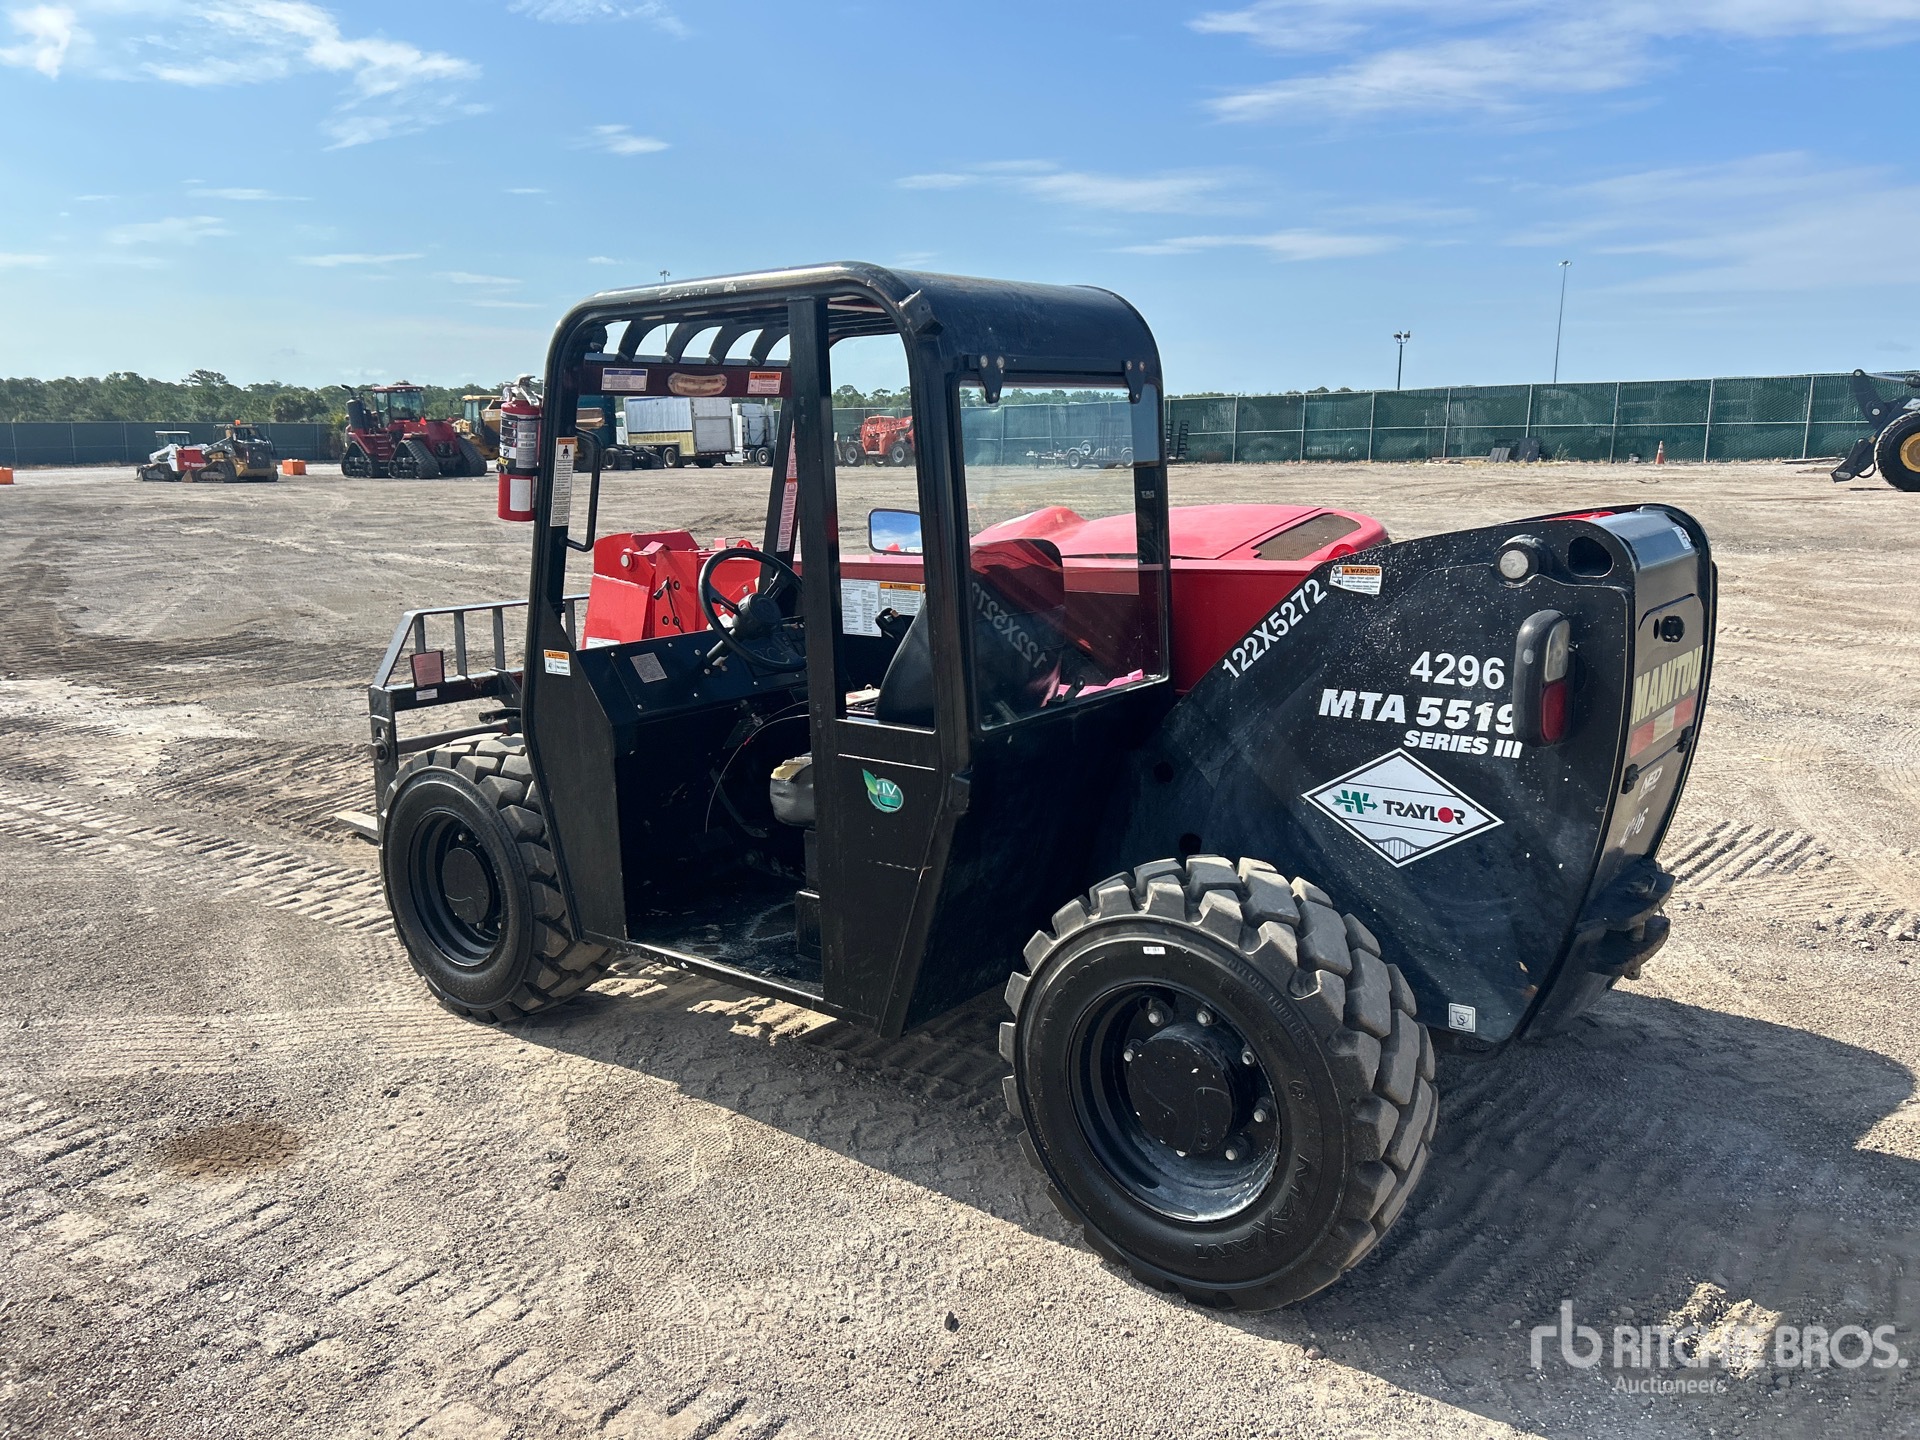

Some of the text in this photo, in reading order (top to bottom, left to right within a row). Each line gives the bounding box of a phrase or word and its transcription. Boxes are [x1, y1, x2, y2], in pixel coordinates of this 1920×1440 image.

[1222, 579, 1328, 678] 122X5272
[1410, 651, 1505, 690] 4296
[1631, 645, 1704, 725] MANITOU
[1318, 688, 1515, 735] MTA 5519
[1403, 730, 1523, 759] SERIES III
[1382, 799, 1466, 826] TRAYLOR
